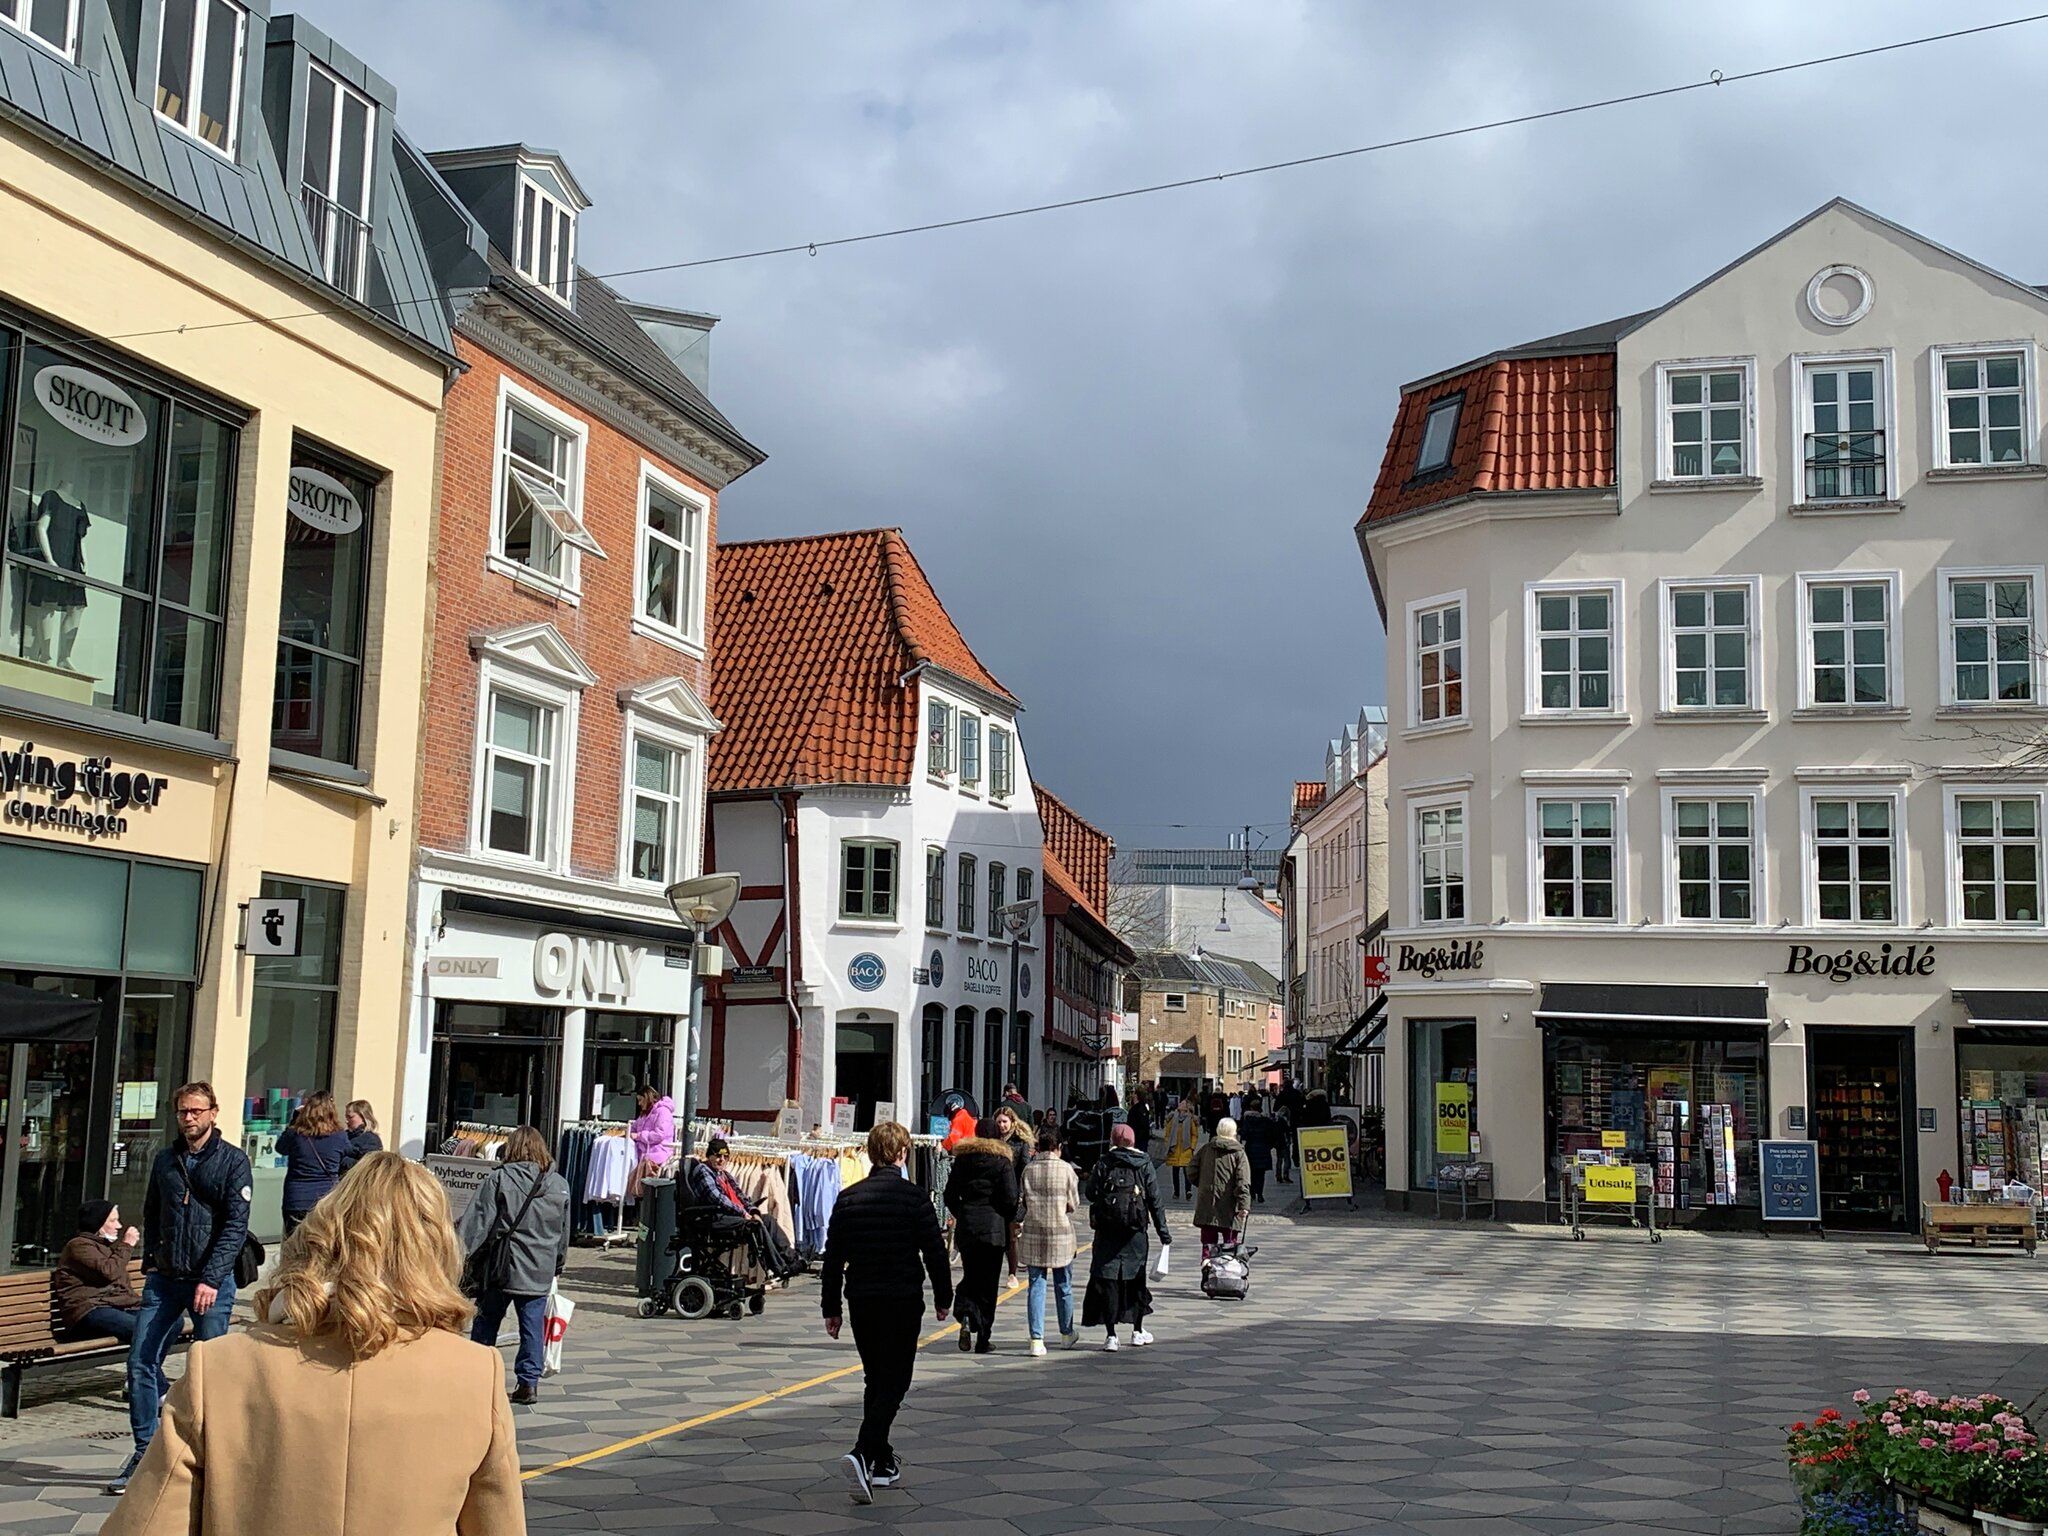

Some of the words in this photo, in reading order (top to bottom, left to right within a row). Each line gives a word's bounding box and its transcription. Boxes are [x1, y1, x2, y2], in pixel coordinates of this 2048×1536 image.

[49, 375, 133, 434] SKOTT
[290, 475, 352, 523] SKOTT
[82, 756, 168, 810] tiger
[8, 800, 128, 836] copenhagen
[438, 960, 488, 974] ONLY
[535, 932, 648, 998] ONLY
[968, 956, 998, 982] BACO
[1397, 940, 1484, 978] Bog&idé
[1784, 943, 1935, 983] Bog&idé
[851, 967, 883, 977] BACO
[964, 982, 981, 993] BAGELS
[985, 985, 1002, 996] COFFEE
[1439, 1103, 1466, 1119] BOG
[1304, 1147, 1345, 1162] BOG
[434, 1166, 474, 1179] Nyheder
[1306, 1162, 1346, 1173] Udsalg
[1589, 1179, 1632, 1189] Udsalg
